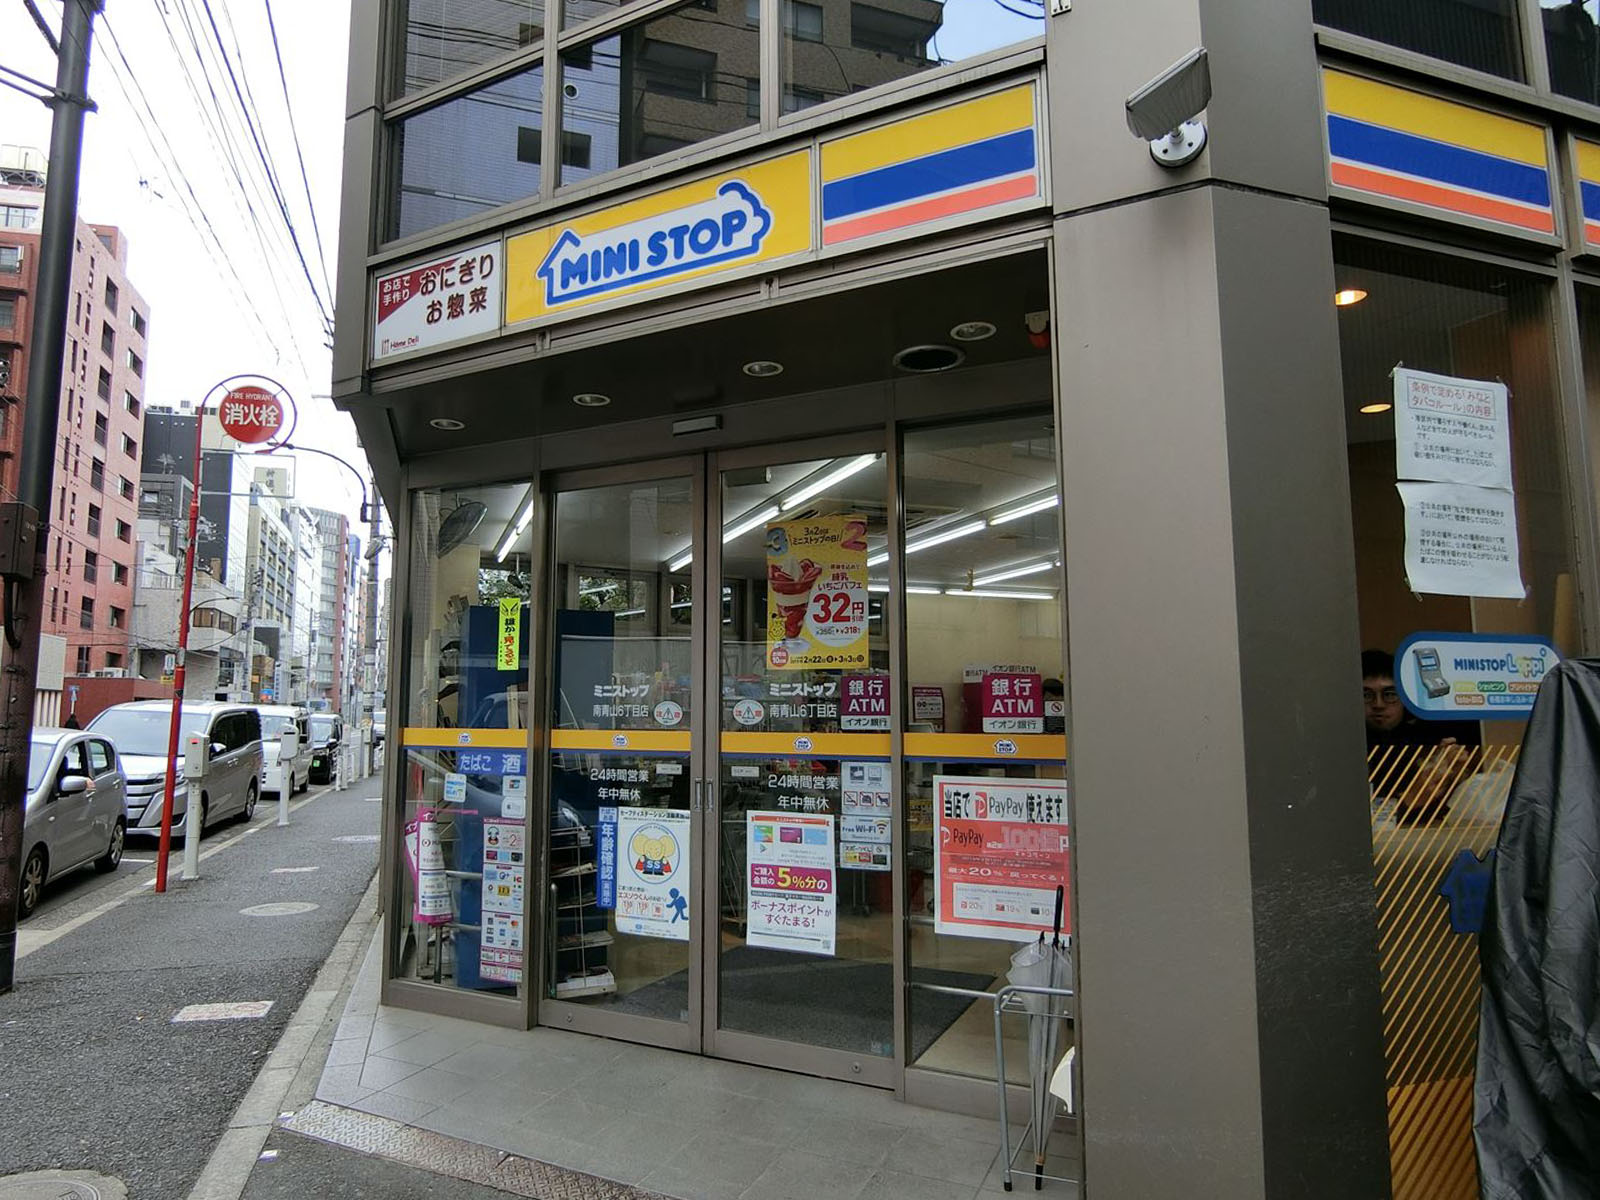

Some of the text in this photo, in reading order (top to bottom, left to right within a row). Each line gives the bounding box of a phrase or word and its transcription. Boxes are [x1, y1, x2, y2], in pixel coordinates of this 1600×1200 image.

[561, 209, 747, 289] MINI STOP
[420, 254, 494, 296] おにぎり
[383, 276, 411, 293] お店で
[383, 289, 410, 307] 手作り
[427, 285, 488, 325] お惣菜
[391, 340, 406, 349] Home
[230, 392, 274, 401] FIRE HYDRANT
[225, 403, 279, 427] 消火栓
[817, 581, 863, 591] いちごパフェ
[992, 665, 1037, 674] イオン銀行ATM
[1454, 658, 1506, 672] MINISTOP
[594, 685, 650, 697] ミニストップ
[769, 682, 837, 697] ミニストップ
[849, 680, 884, 696] 銀行
[992, 679, 1033, 697] 銀行
[593, 704, 649, 718] 南青山6丁目店
[769, 703, 837, 718] 南青山6丁目店
[849, 698, 886, 713] ATM
[992, 699, 1035, 714] ATM
[846, 718, 888, 727] イオン銀行
[990, 720, 1037, 730] イオン銀行
[460, 753, 522, 773] たばこ 酒
[590, 768, 649, 782] 24時間営業
[768, 774, 840, 790] 24時間営業
[598, 787, 641, 801] 年中無休
[777, 795, 830, 811] 年中無休
[944, 789, 1063, 824] 当店で PayPay 使えます
[855, 824, 877, 833] Wi-Fi
[953, 827, 984, 848] PayPay
[753, 867, 775, 877] ご購入
[777, 867, 829, 891] 5%分の
[753, 875, 776, 886] 金額の
[765, 913, 816, 929] すぐたまる!
